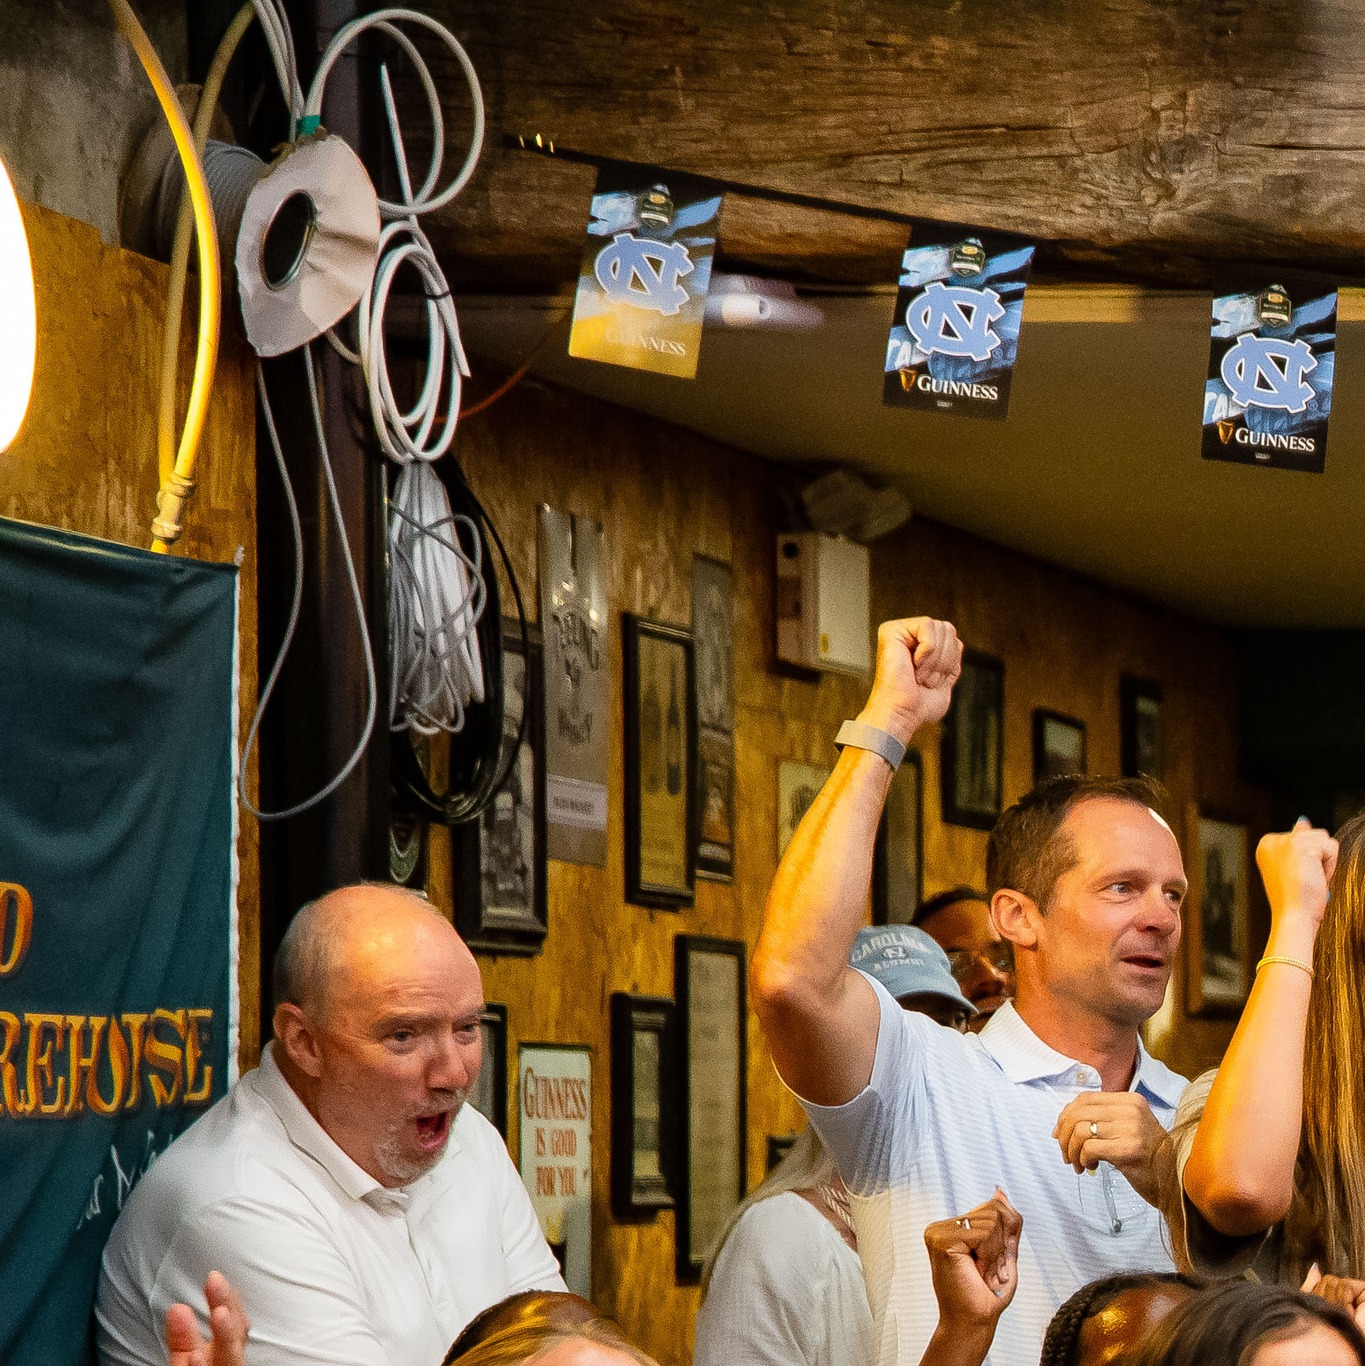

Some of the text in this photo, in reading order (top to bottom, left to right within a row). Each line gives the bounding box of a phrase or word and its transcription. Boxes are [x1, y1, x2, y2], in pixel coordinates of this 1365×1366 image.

[917, 374, 999, 401] GUINNESS
[1235, 426, 1316, 453] GUINNESS
[523, 1067, 587, 1121] GUINNESS
[535, 1127, 577, 1158] IS GOOD
[535, 1166, 576, 1197] FOR YOU
